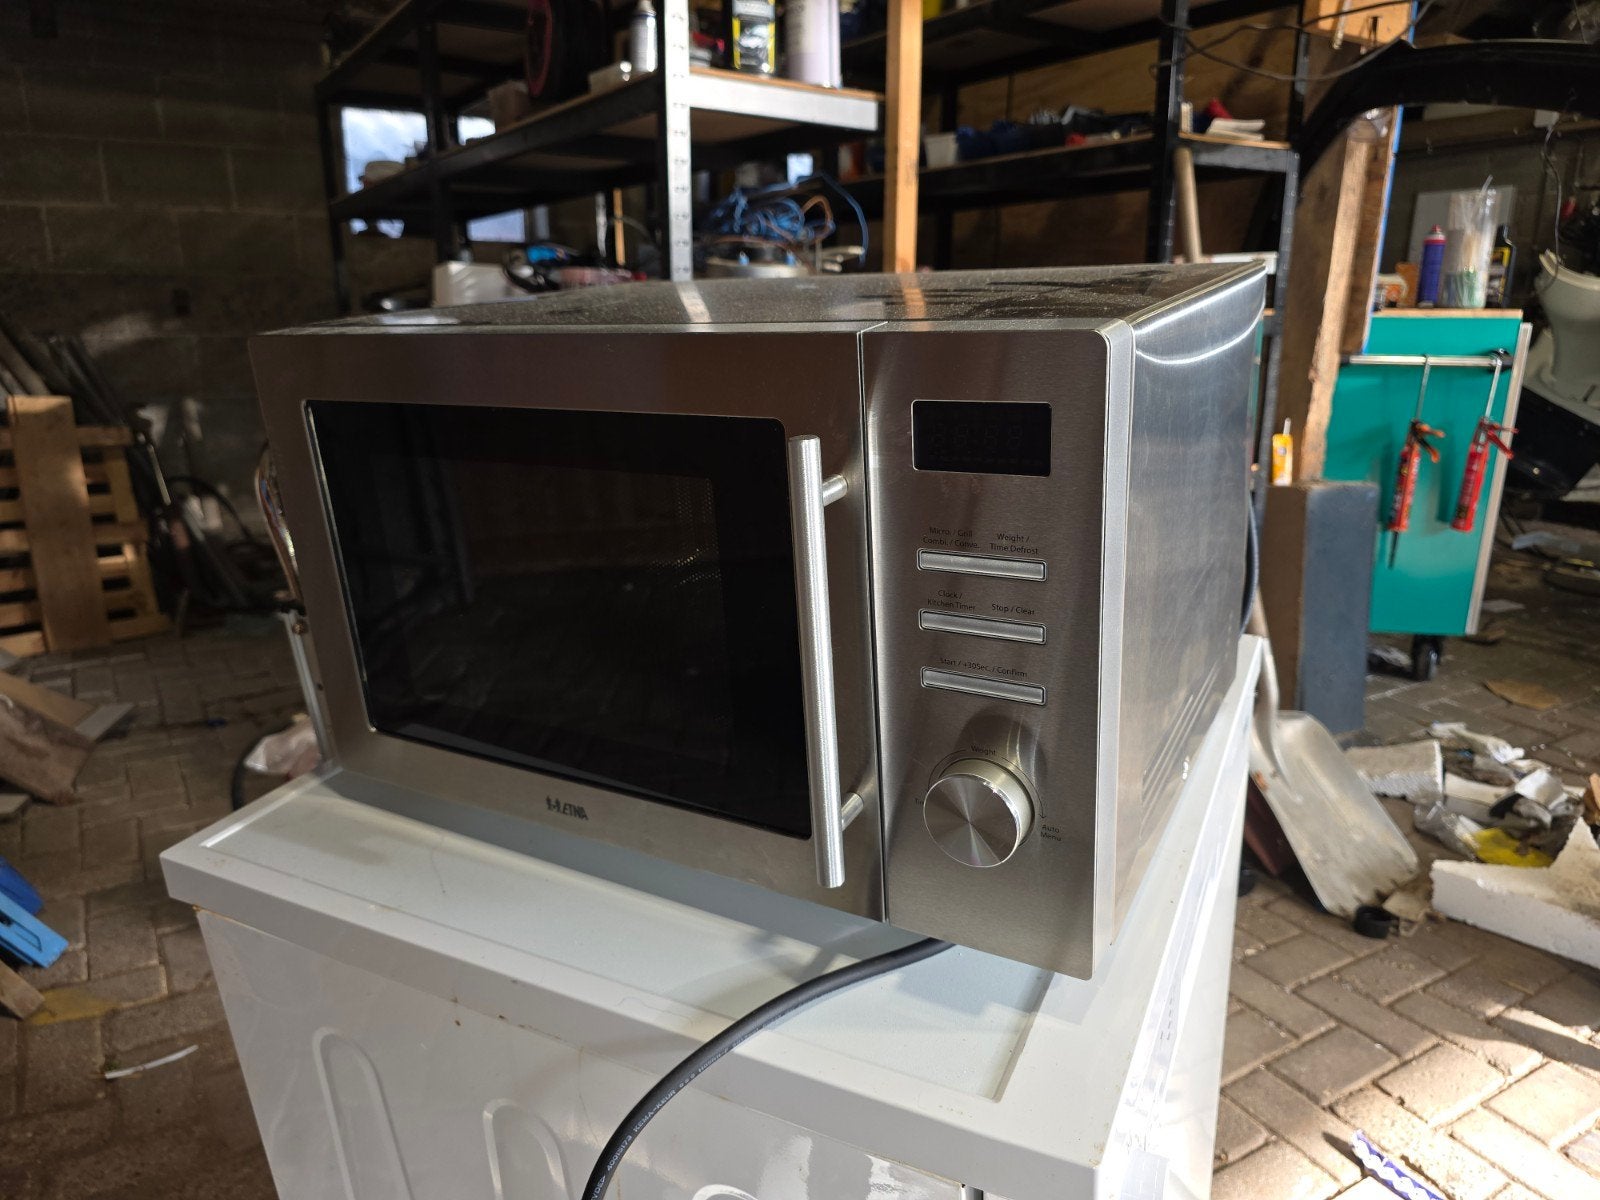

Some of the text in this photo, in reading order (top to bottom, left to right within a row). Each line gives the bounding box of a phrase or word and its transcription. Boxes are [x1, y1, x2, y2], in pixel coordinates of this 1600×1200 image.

[957, 529, 973, 538] Grill
[997, 533, 1024, 542] Weight
[990, 542, 1038, 555] Time Defrost
[938, 589, 957, 598] Clock
[927, 598, 976, 611] Kitchen Timer
[991, 603, 1009, 613] Stop
[1015, 606, 1035, 615] Clear
[940, 658, 956, 666] Start
[997, 666, 1028, 677] Confirm
[970, 745, 996, 757] Weight
[1042, 824, 1060, 834] Auto
[1040, 831, 1062, 842] Menu
